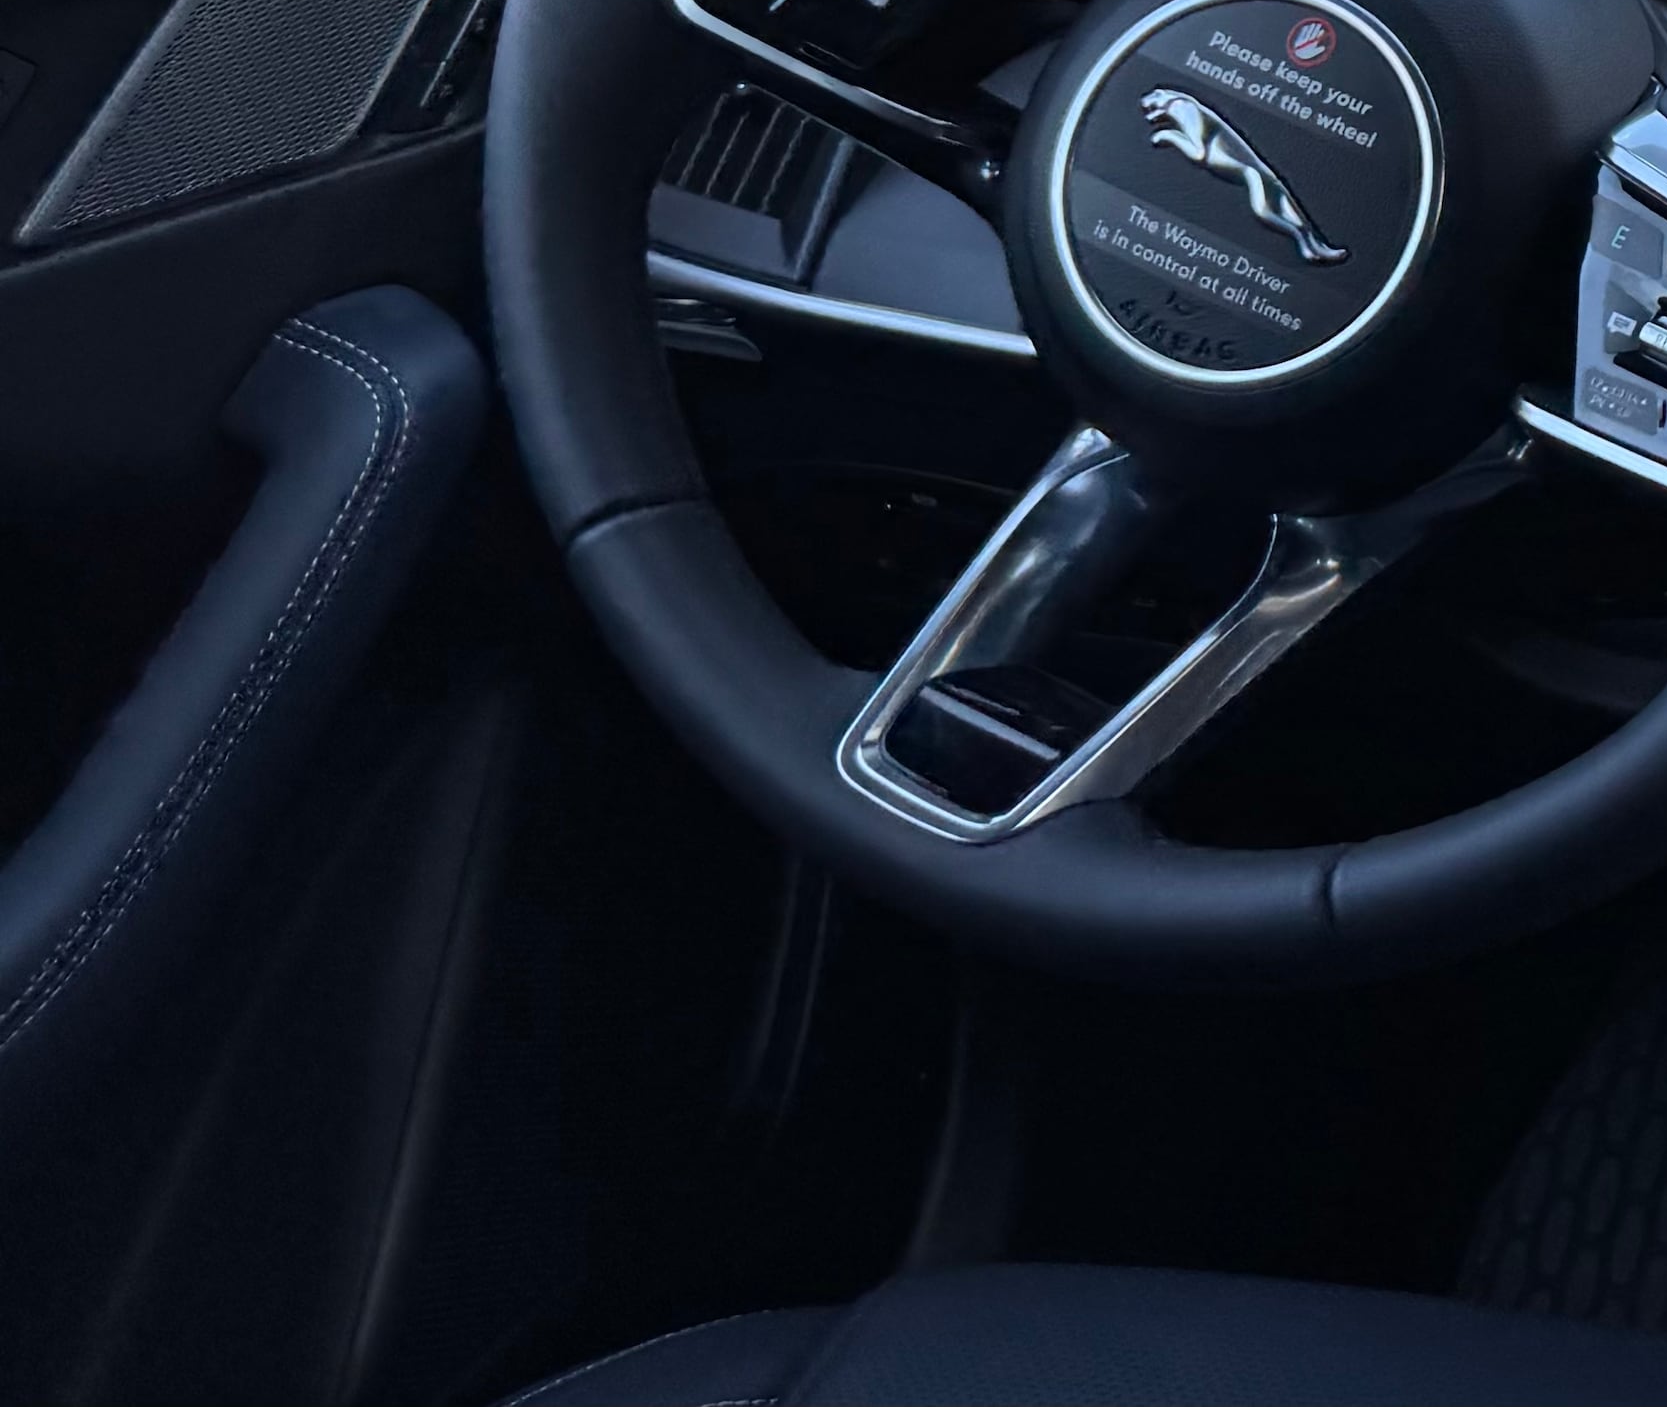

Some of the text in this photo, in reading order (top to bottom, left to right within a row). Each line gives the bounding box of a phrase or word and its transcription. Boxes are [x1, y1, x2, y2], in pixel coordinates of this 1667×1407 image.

[1185, 50, 1379, 149] hands off the wheel
[1209, 31, 1374, 116] Please keep your
[1093, 219, 1303, 332] is in control at all times
[1128, 205, 1291, 295] The Waymo Driver
[1611, 225, 1630, 250] E
